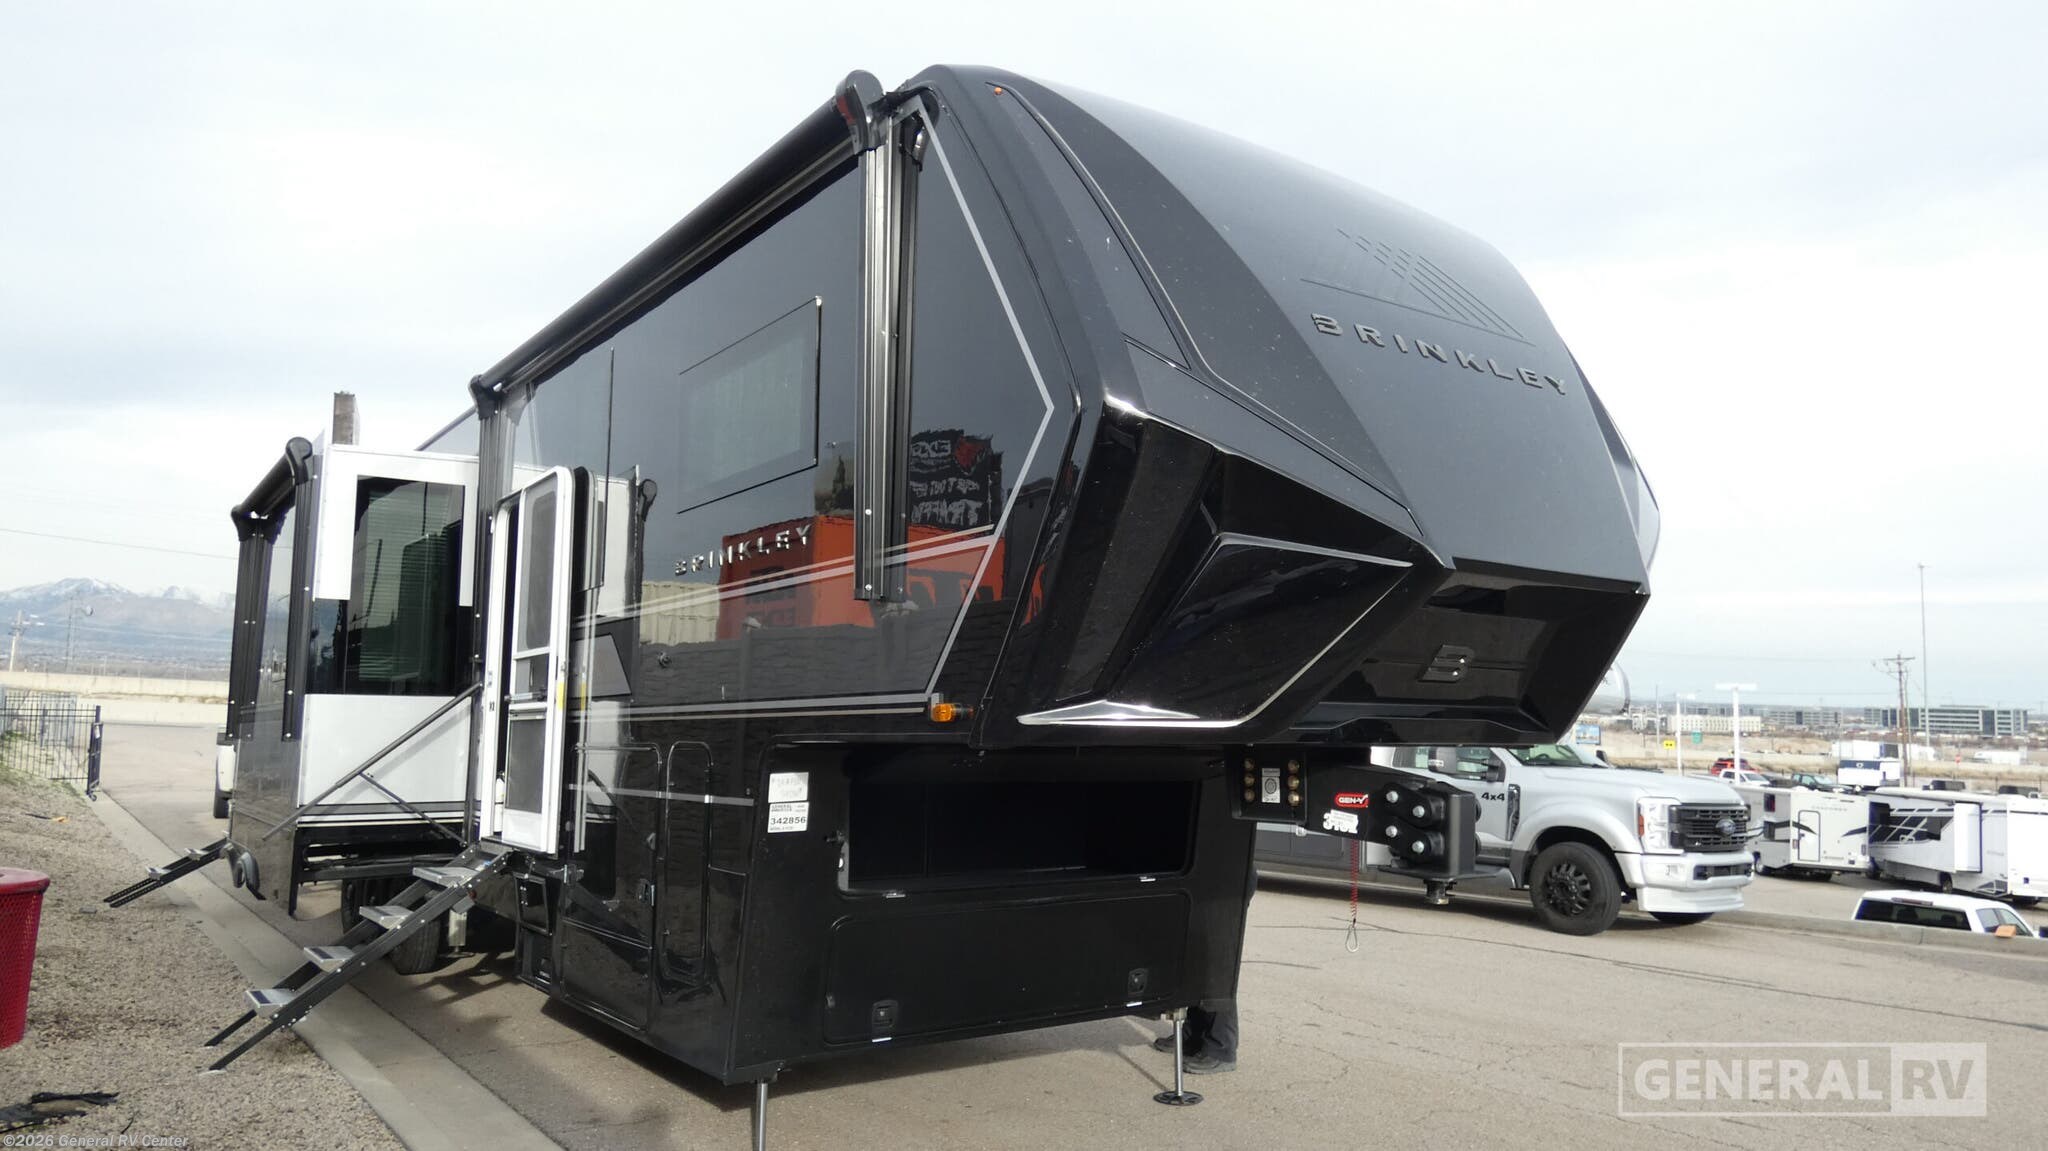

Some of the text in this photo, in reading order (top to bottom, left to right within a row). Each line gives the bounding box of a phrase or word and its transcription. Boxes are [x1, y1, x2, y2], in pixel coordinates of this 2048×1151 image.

[1310, 312, 1567, 395] BRINKLEY
[674, 524, 811, 576] BRINKLEY
[1481, 792, 1505, 801] 4x4
[770, 816, 806, 825] 342856
